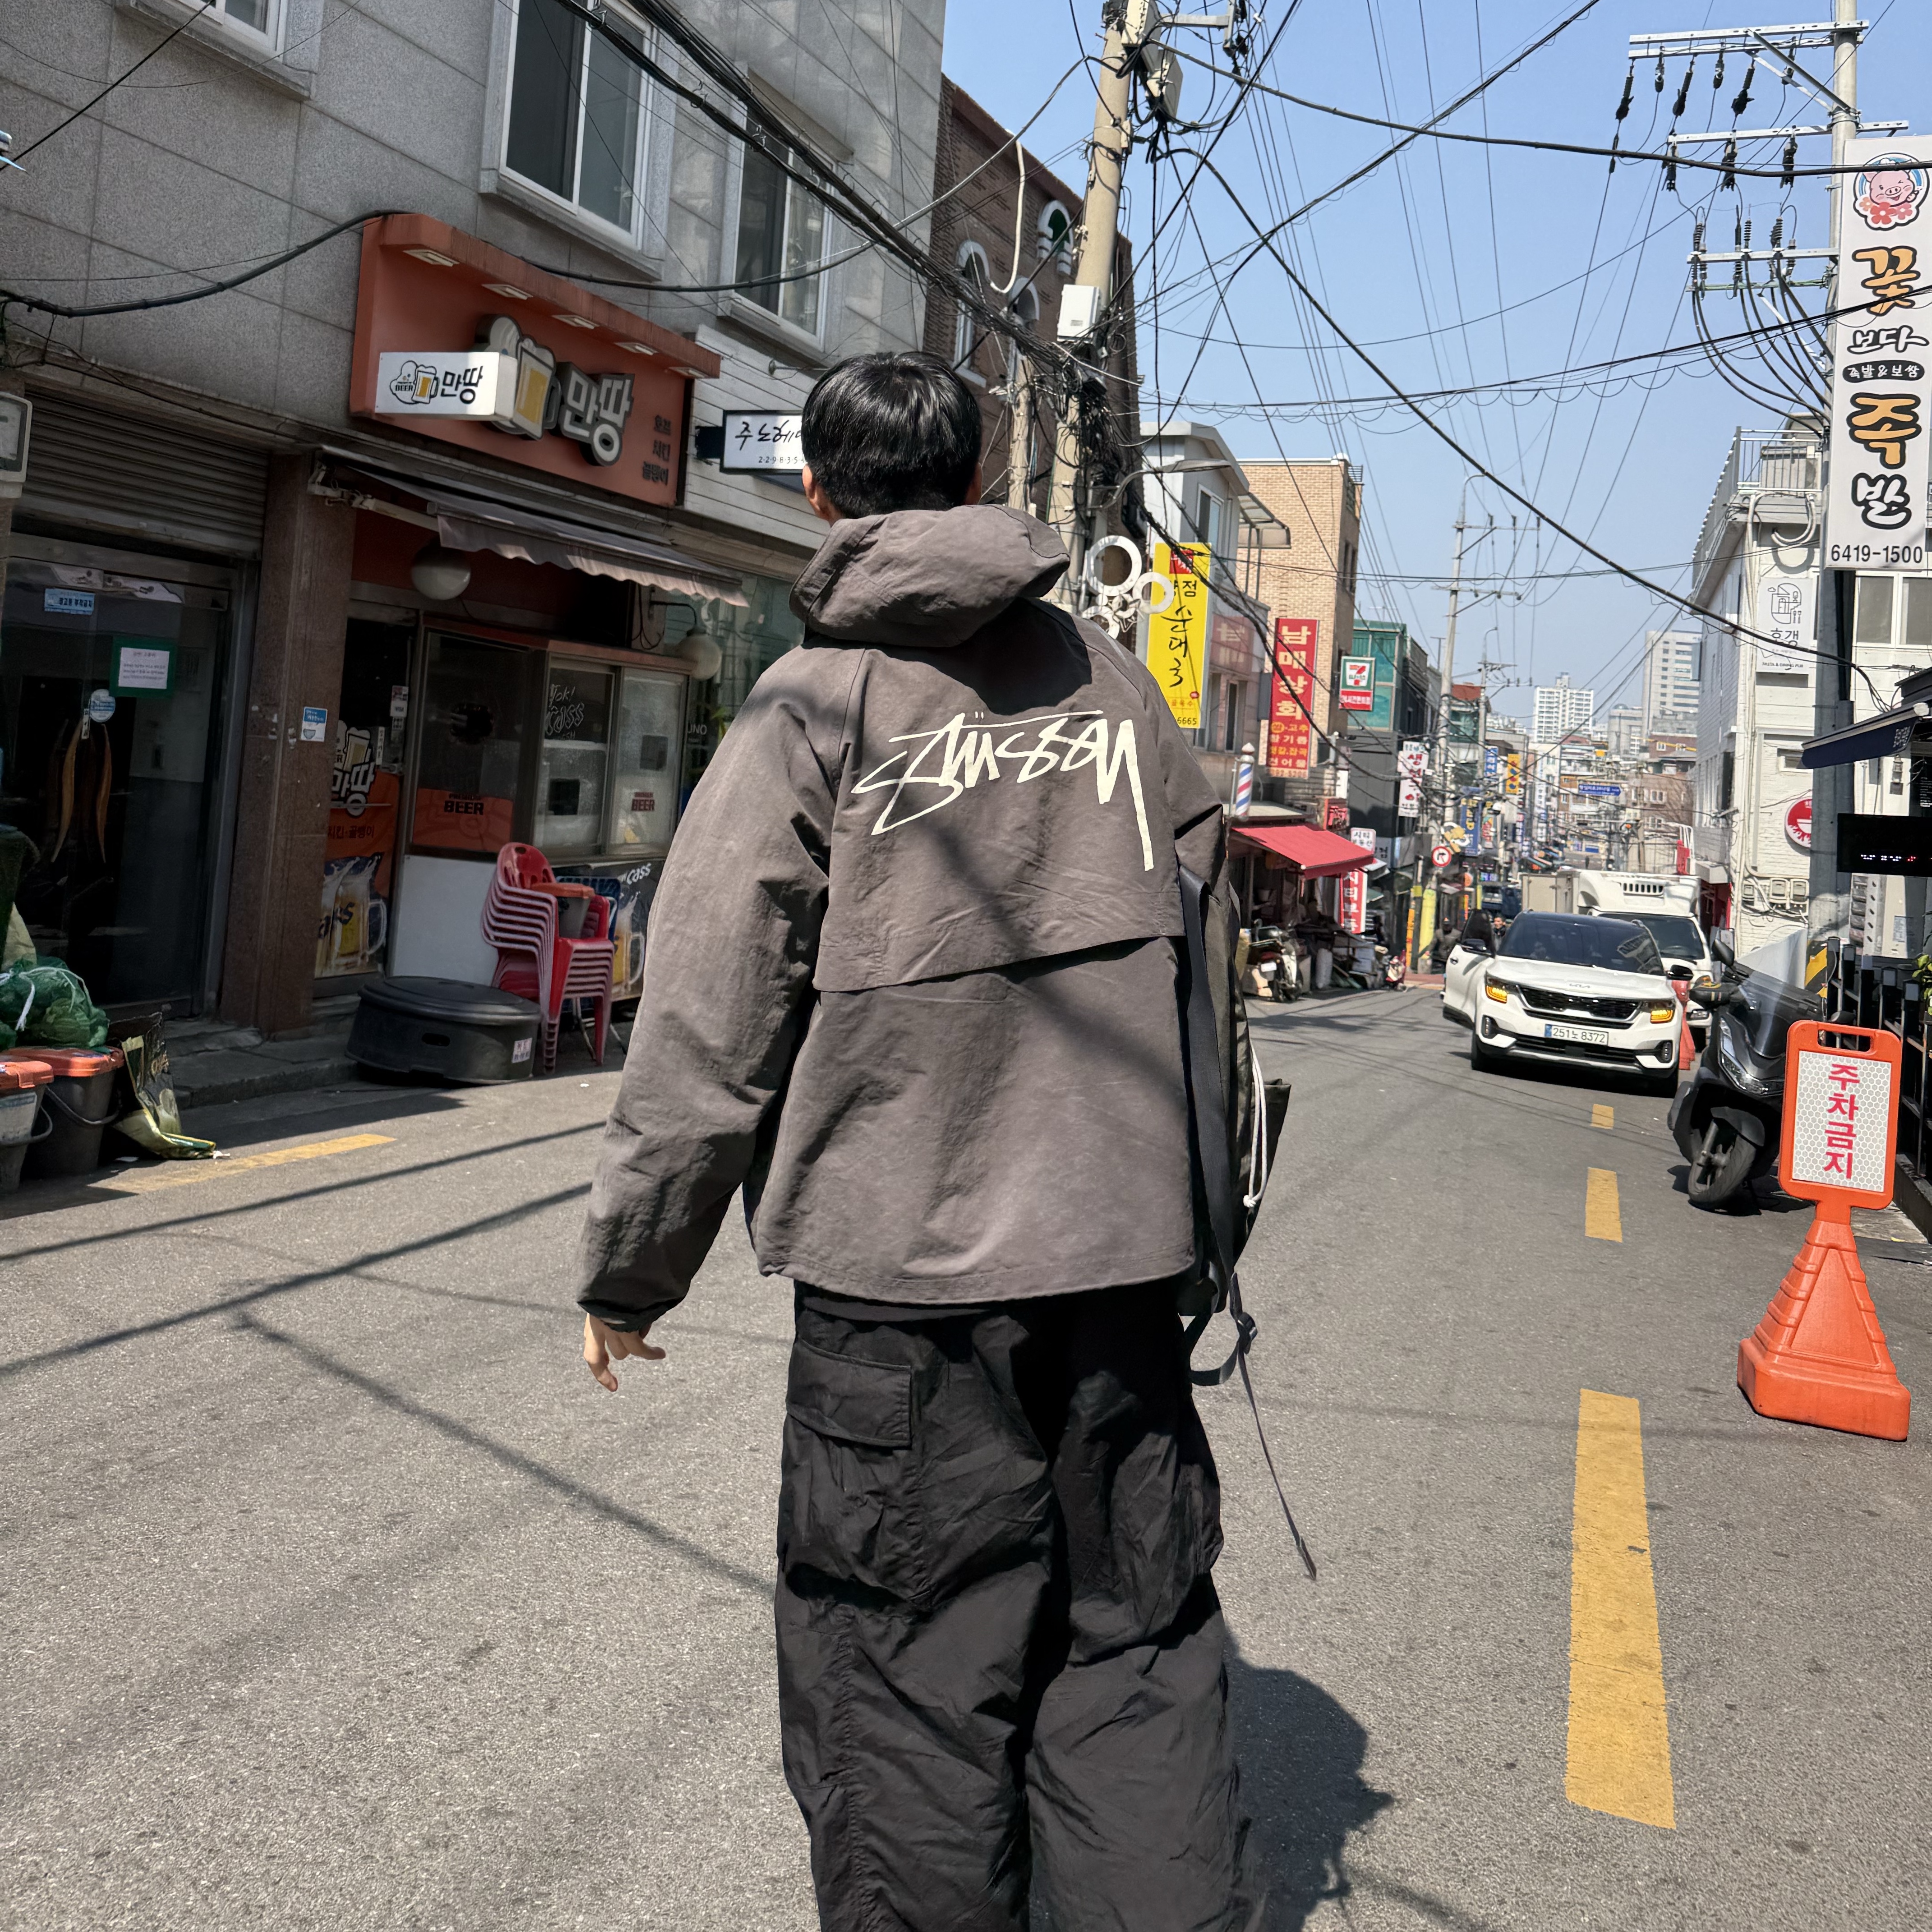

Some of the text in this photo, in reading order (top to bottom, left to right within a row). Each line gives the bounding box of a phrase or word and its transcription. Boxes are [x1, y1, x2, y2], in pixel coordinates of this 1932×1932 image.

[1852, 246, 1921, 316] 꽃
[1847, 325, 1929, 354] 보다
[441, 365, 484, 404] 만땅
[562, 372, 633, 463] 만땅
[1831, 544, 1923, 563] 6419-1500
[1164, 580, 1197, 597] 점
[1275, 626, 1310, 720] 남매상회
[1177, 717, 1197, 725] 6665
[444, 801, 484, 815] BEER
[1581, 1031, 1605, 1043] 8372
[1823, 1063, 1860, 1180] 주차금지
